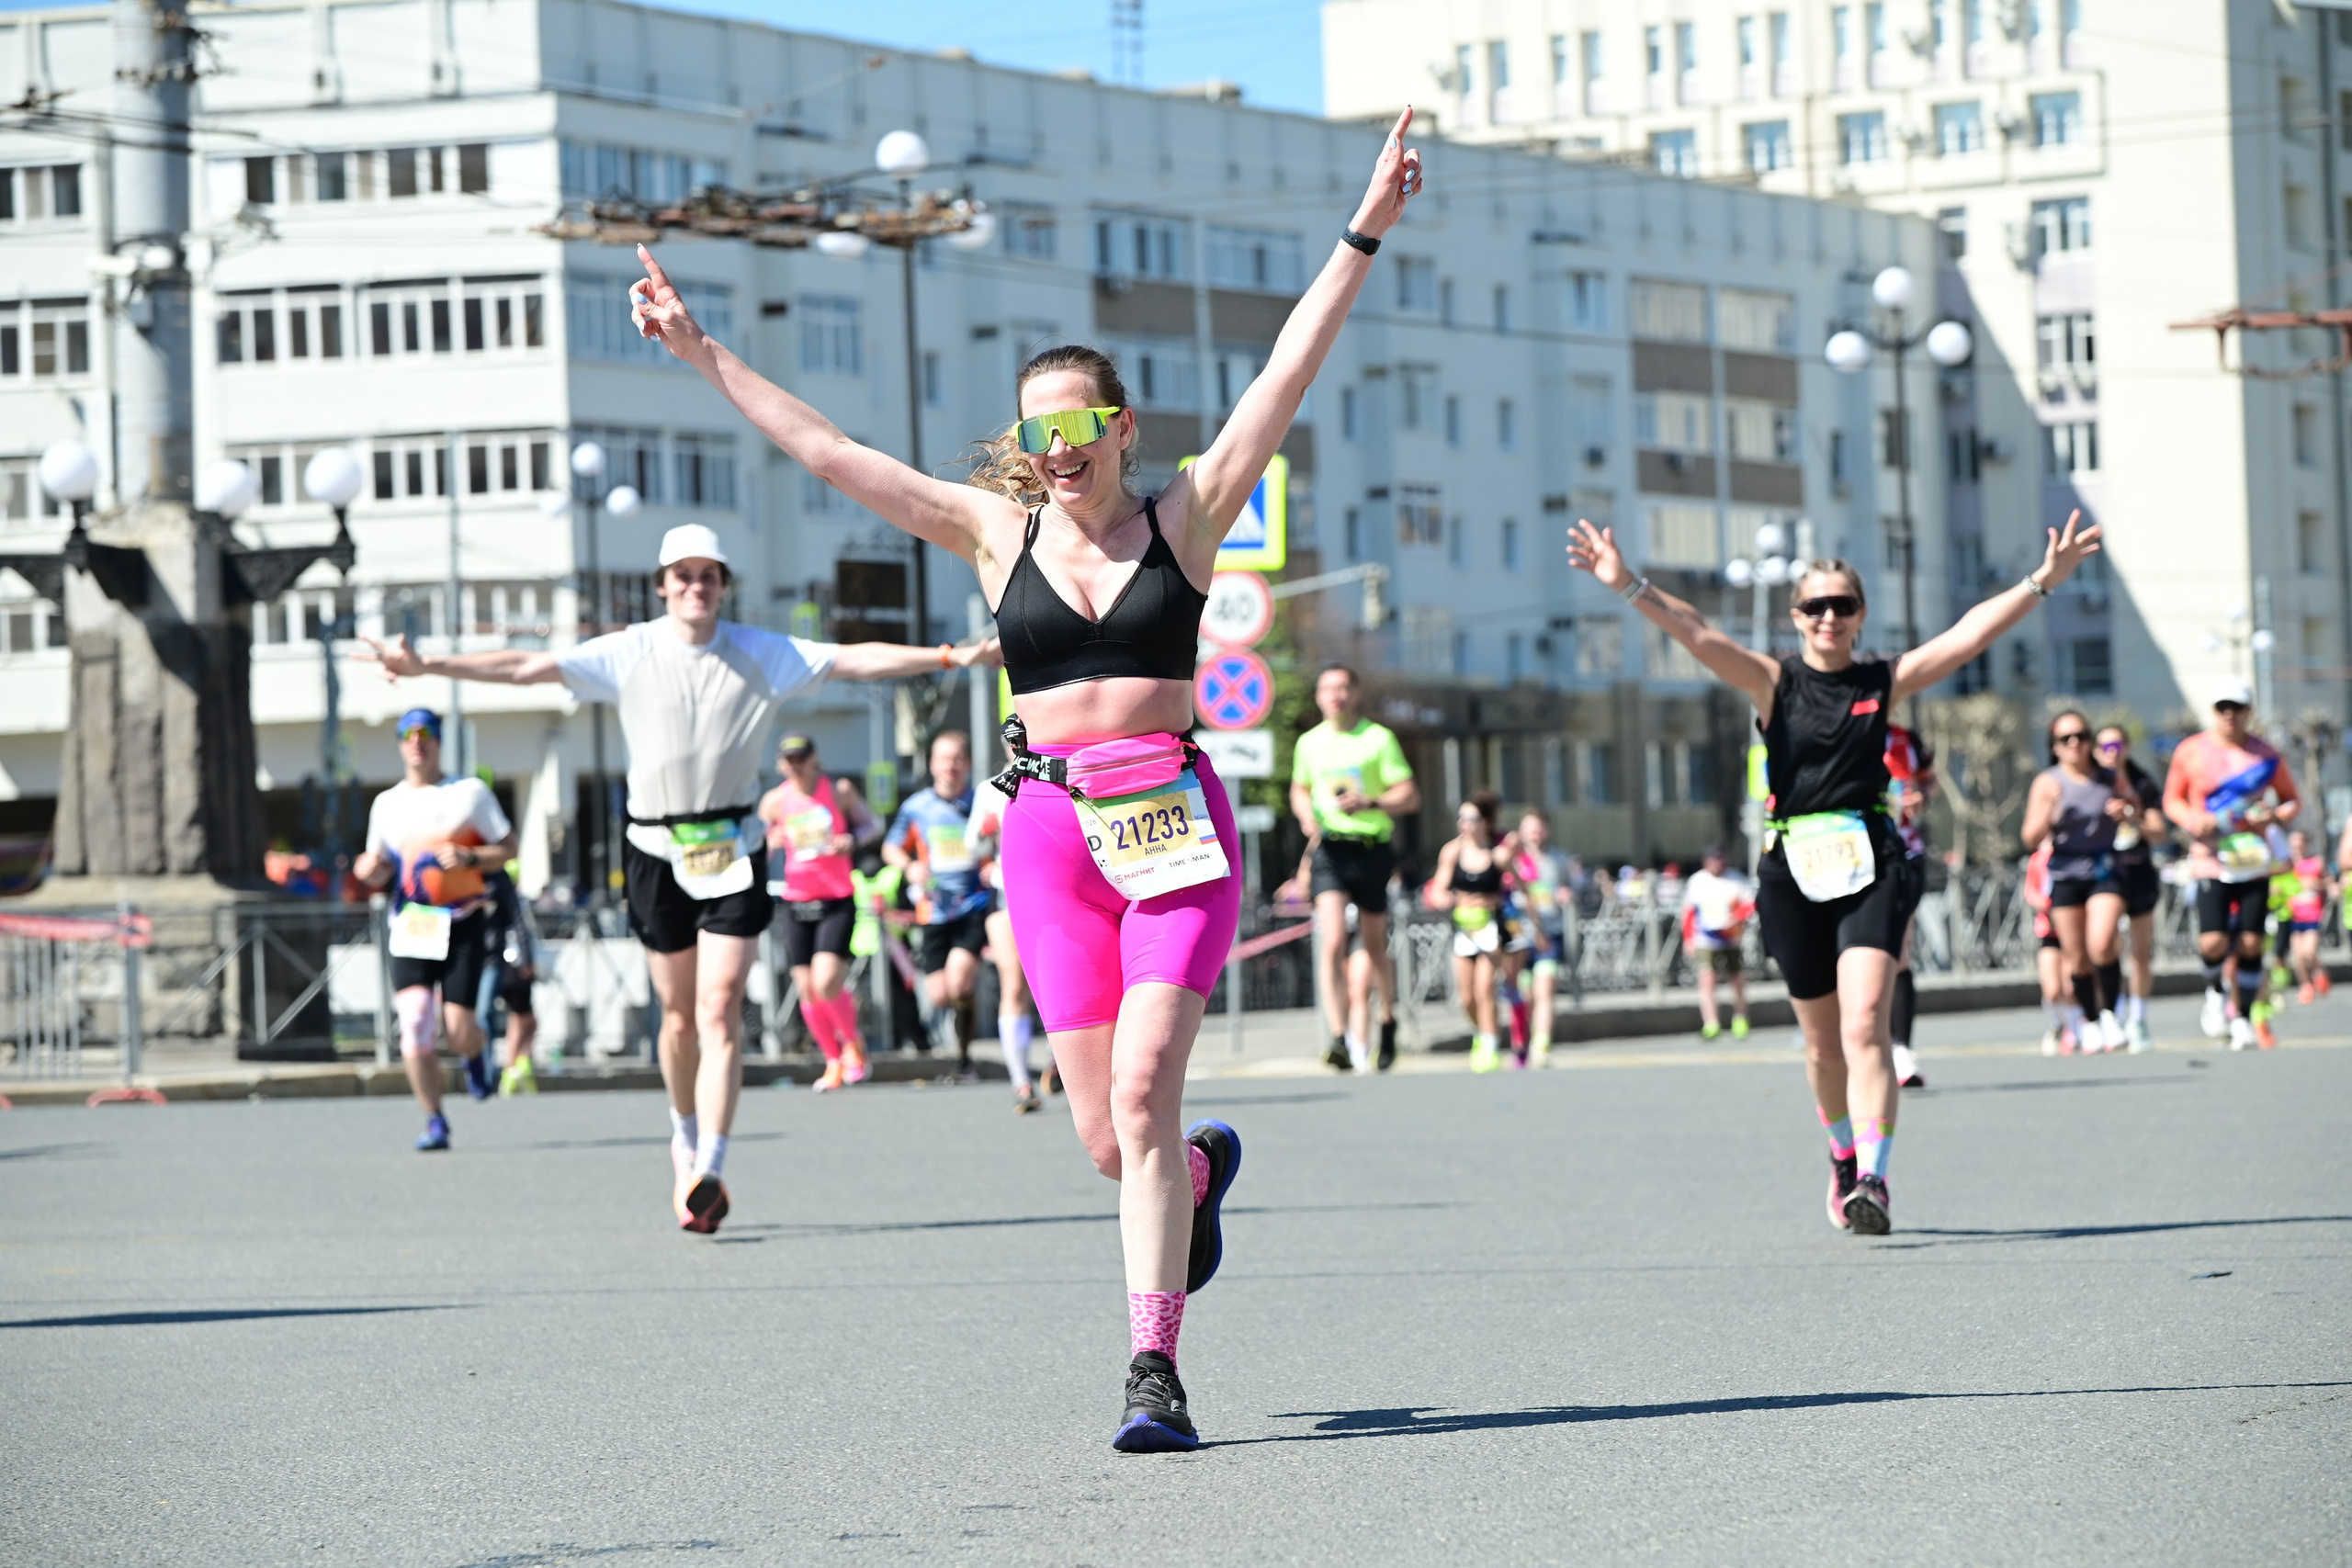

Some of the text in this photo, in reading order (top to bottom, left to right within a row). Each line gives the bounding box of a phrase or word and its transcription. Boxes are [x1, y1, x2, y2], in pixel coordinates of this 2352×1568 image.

[1212, 593, 1256, 626] 40
[1110, 805, 1190, 851] 21233
[1087, 835, 1102, 852] D
[1145, 843, 1168, 856] АННА
[1124, 867, 1155, 881] МАГНИТ
